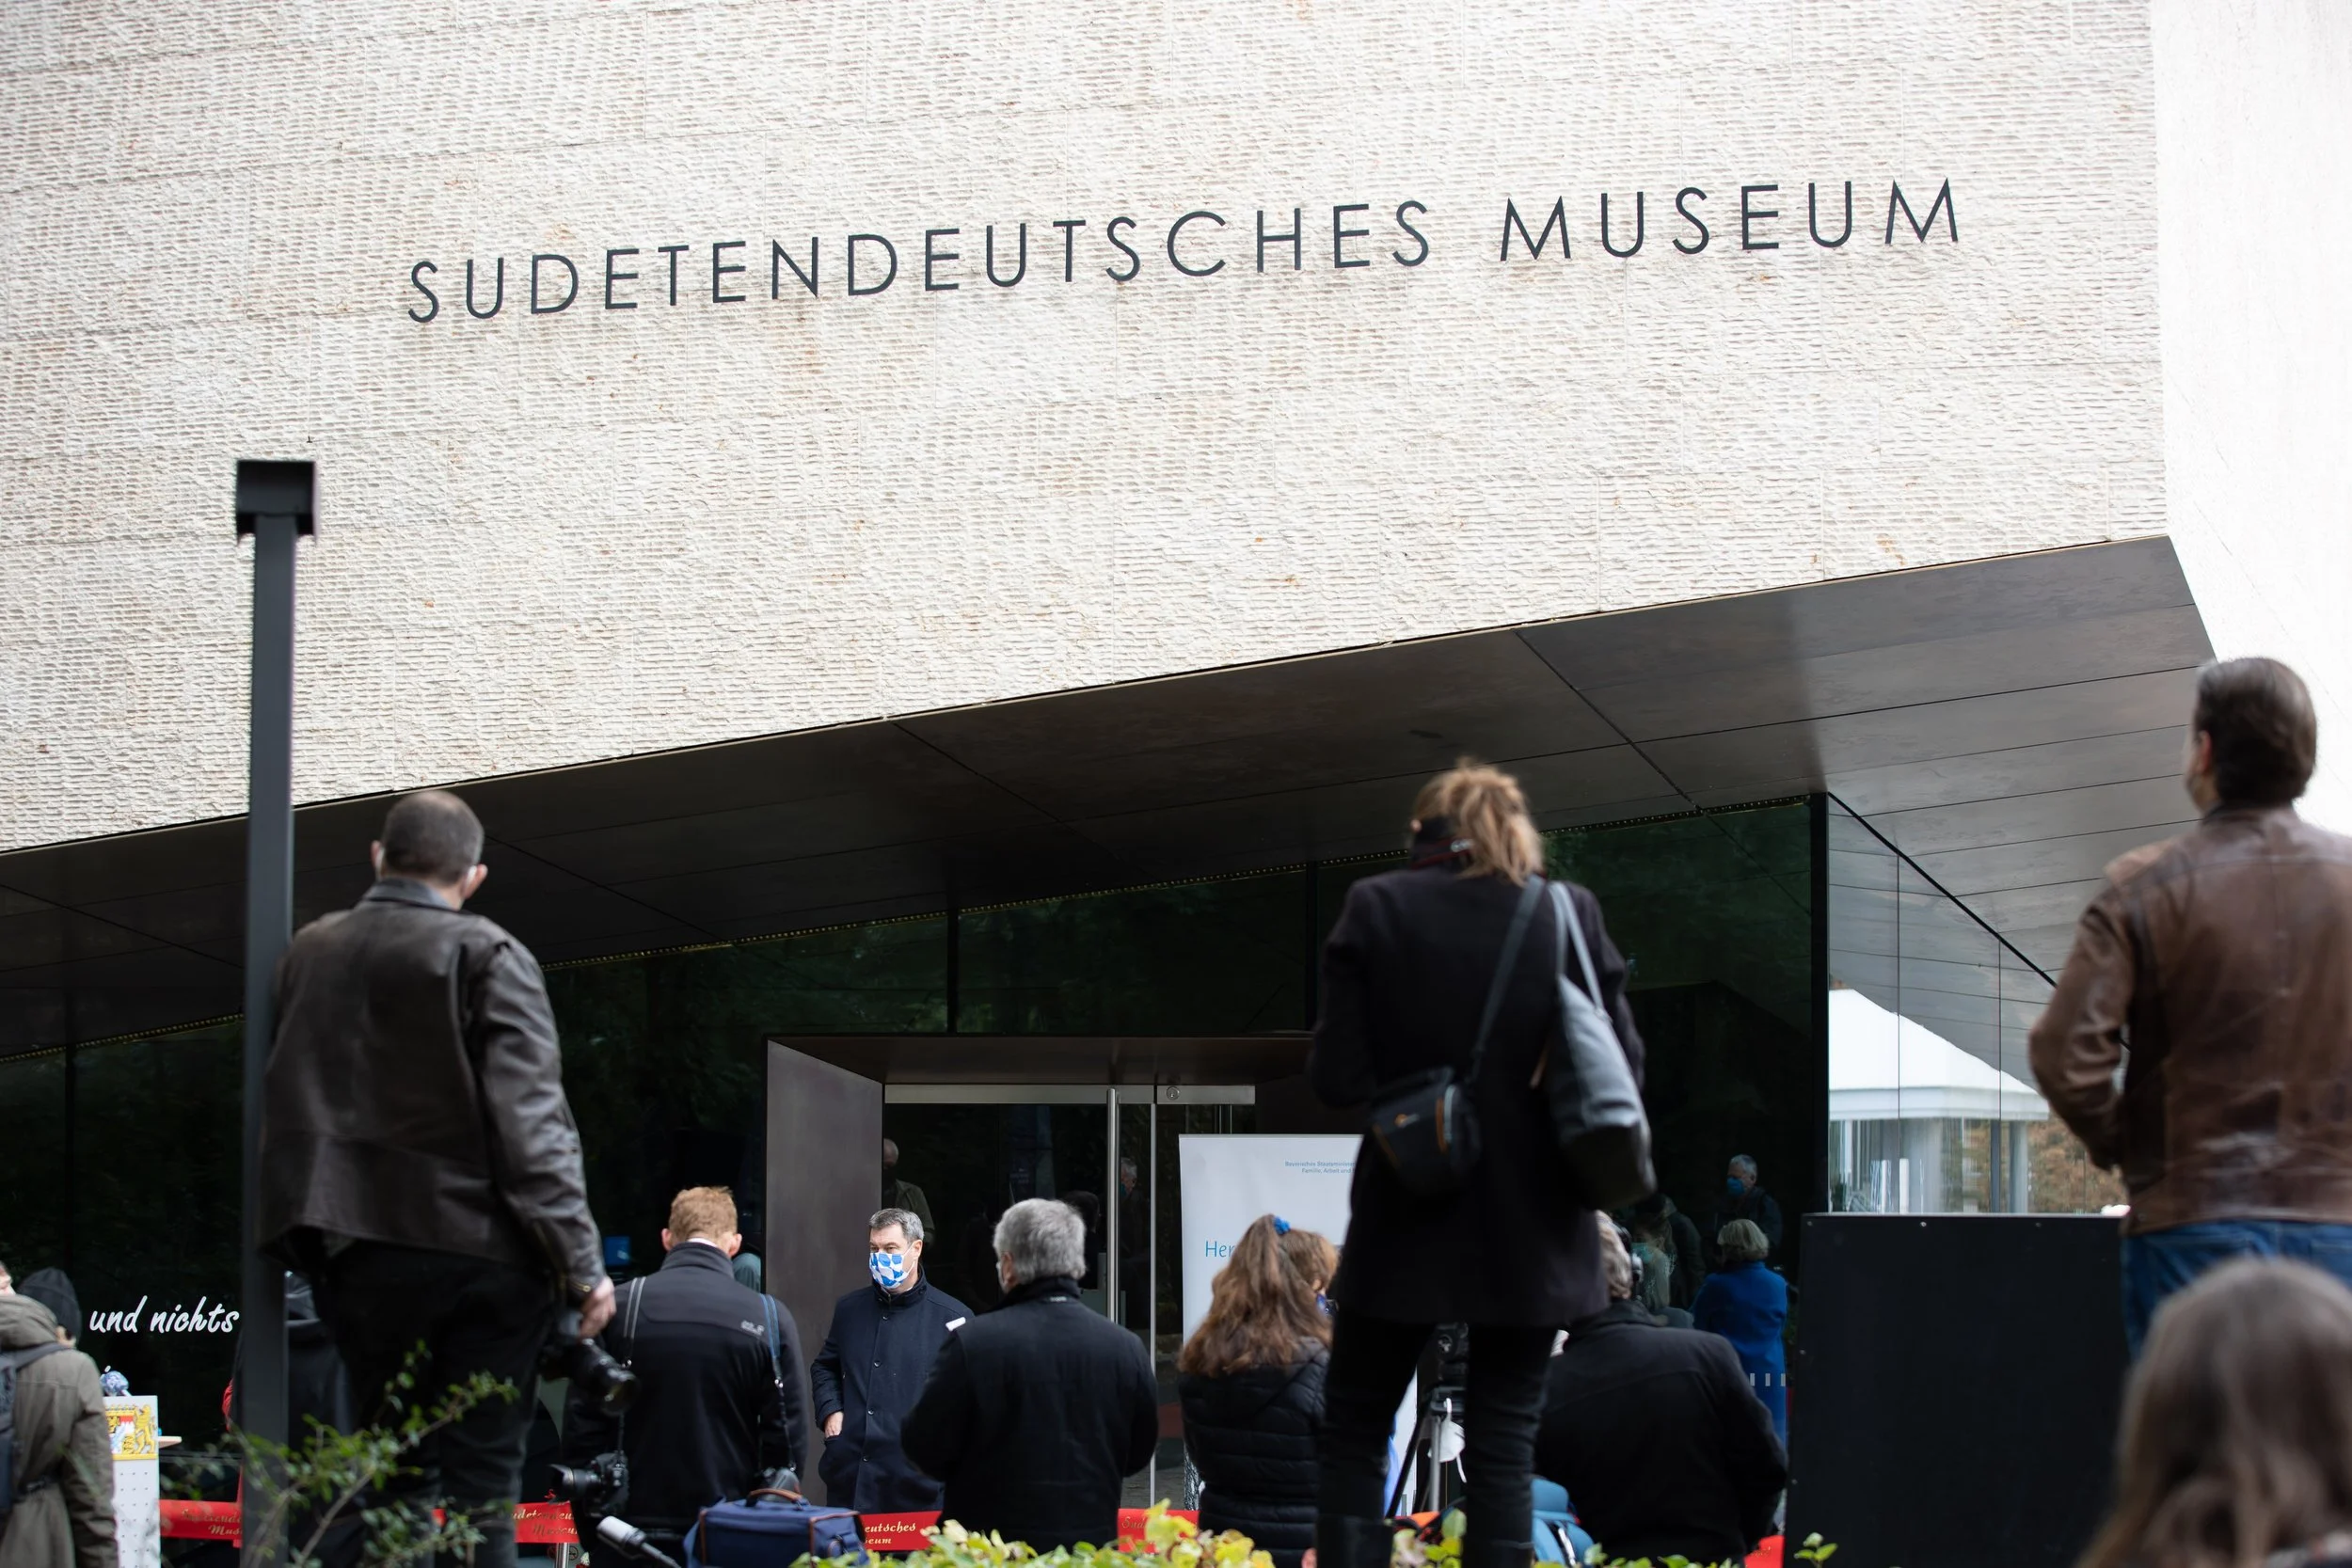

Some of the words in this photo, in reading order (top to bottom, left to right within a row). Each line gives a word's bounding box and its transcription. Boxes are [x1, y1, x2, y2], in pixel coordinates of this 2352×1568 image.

[408, 200, 1428, 323] SUDETENDEUTSCHES
[1501, 178, 1959, 261] MUSEUM
[89, 1295, 148, 1333] und
[150, 1296, 240, 1334] nichts
